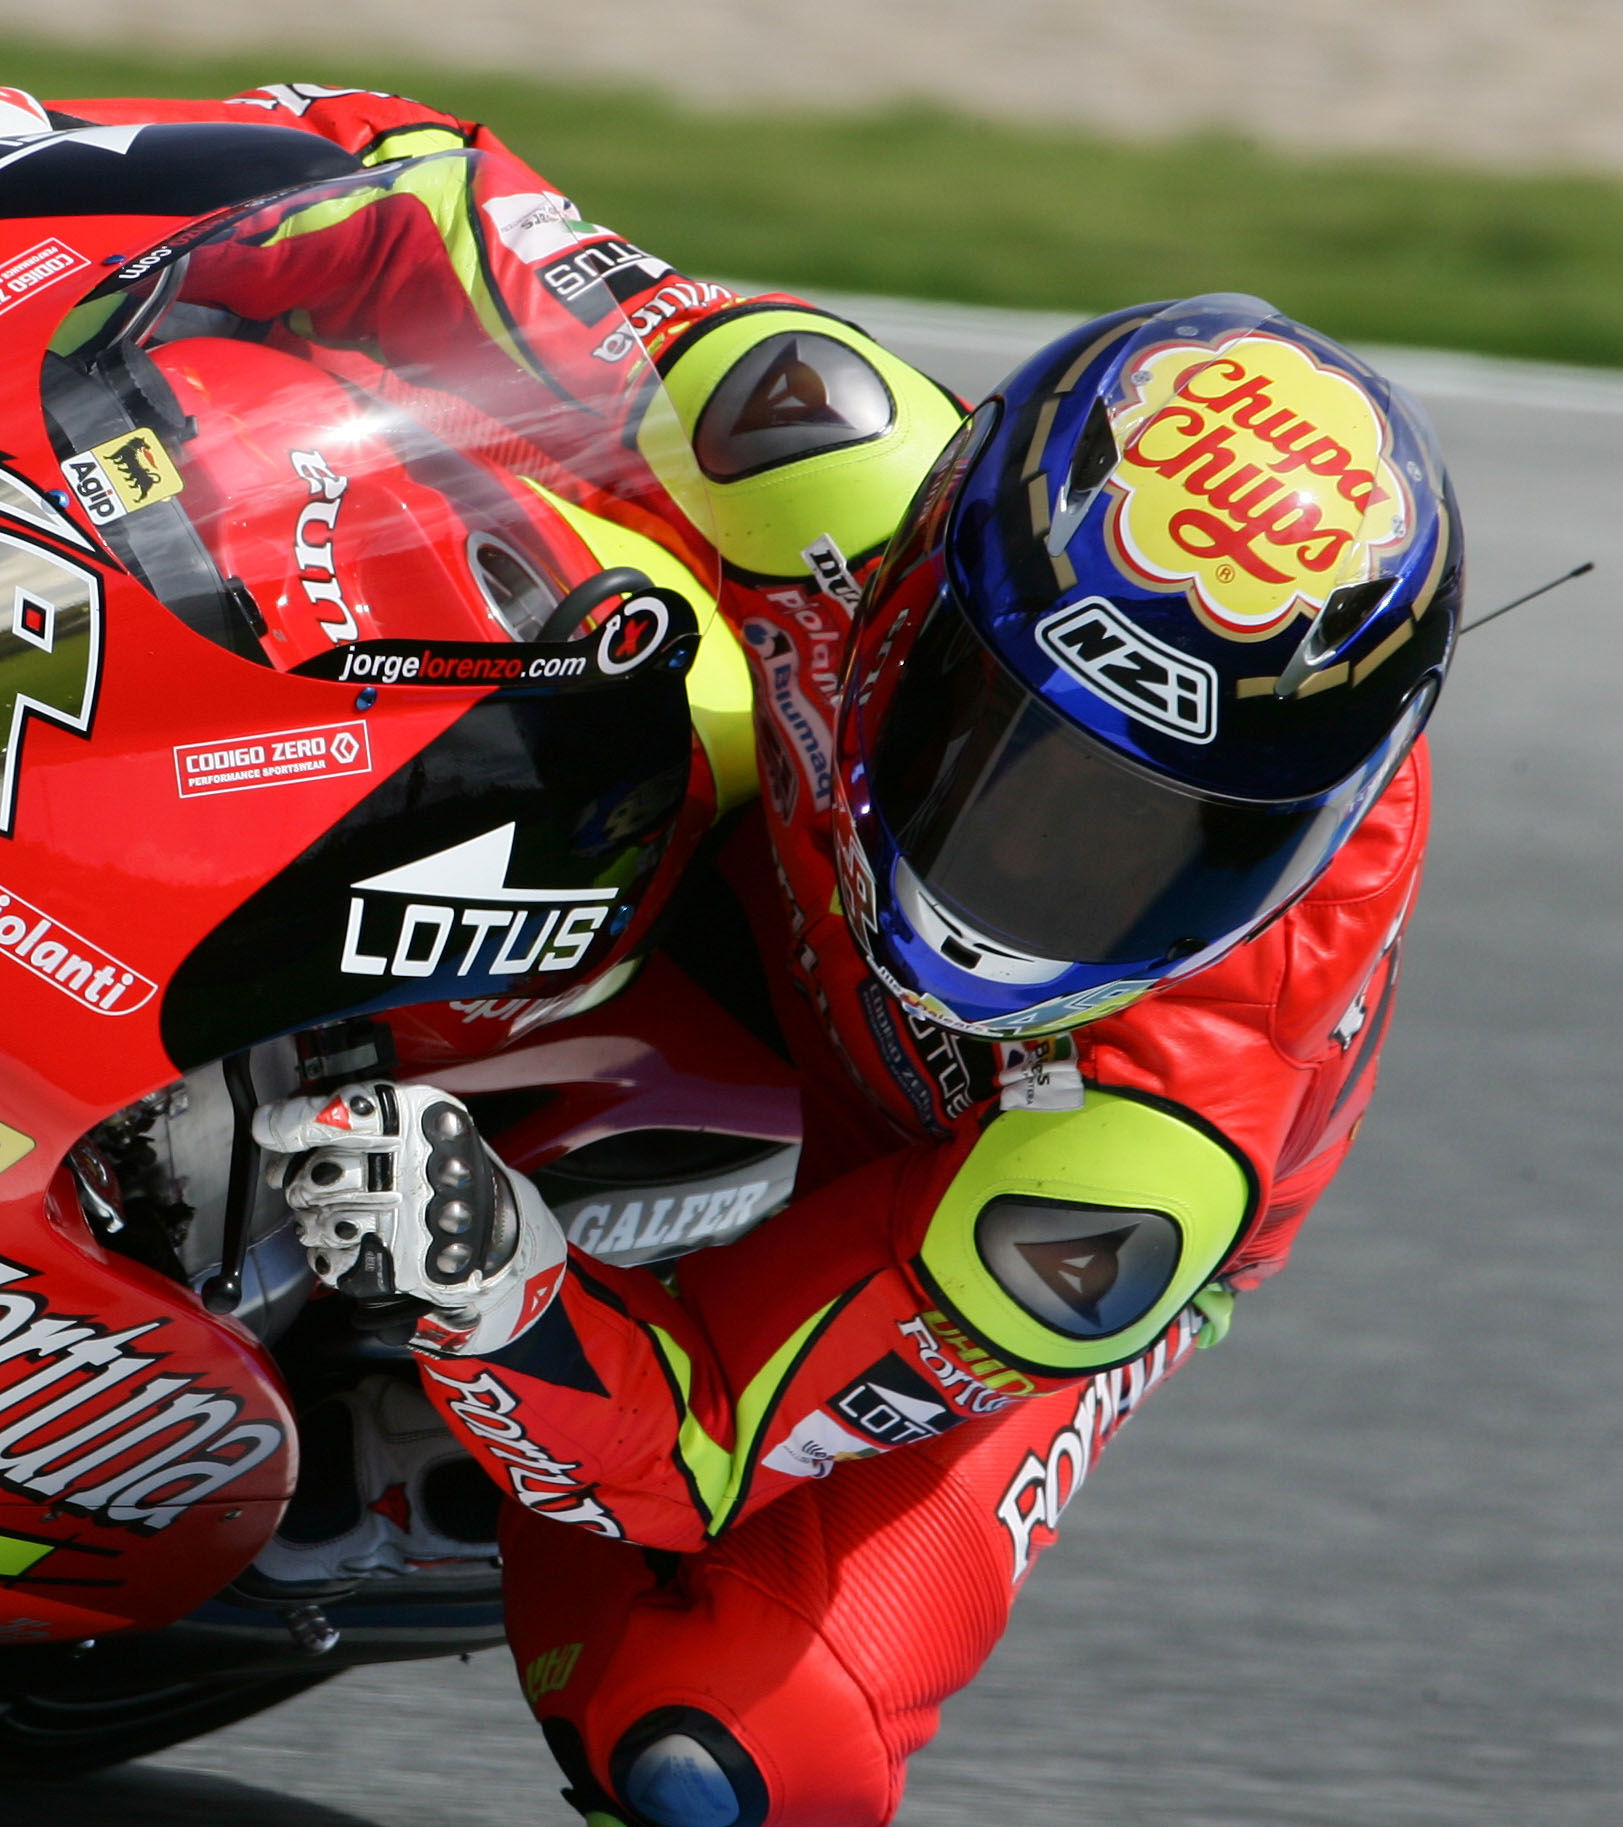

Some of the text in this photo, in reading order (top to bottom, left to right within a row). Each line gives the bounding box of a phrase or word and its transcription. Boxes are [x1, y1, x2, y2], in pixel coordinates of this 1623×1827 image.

[7, 252, 75, 293] CODIGO
[1176, 358, 1390, 512] Chupa
[70, 457, 120, 525] Agip
[1123, 405, 1353, 585] Chups
[338, 647, 587, 683] jorgelorenzo.com
[185, 737, 326, 775] CODIGO ZERO
[772, 662, 832, 799] Blumaq
[187, 758, 326, 788] PERFORMANCE SPORTSWEAR
[340, 896, 609, 978] LOTUS
[572, 1180, 769, 1253] GALFER
